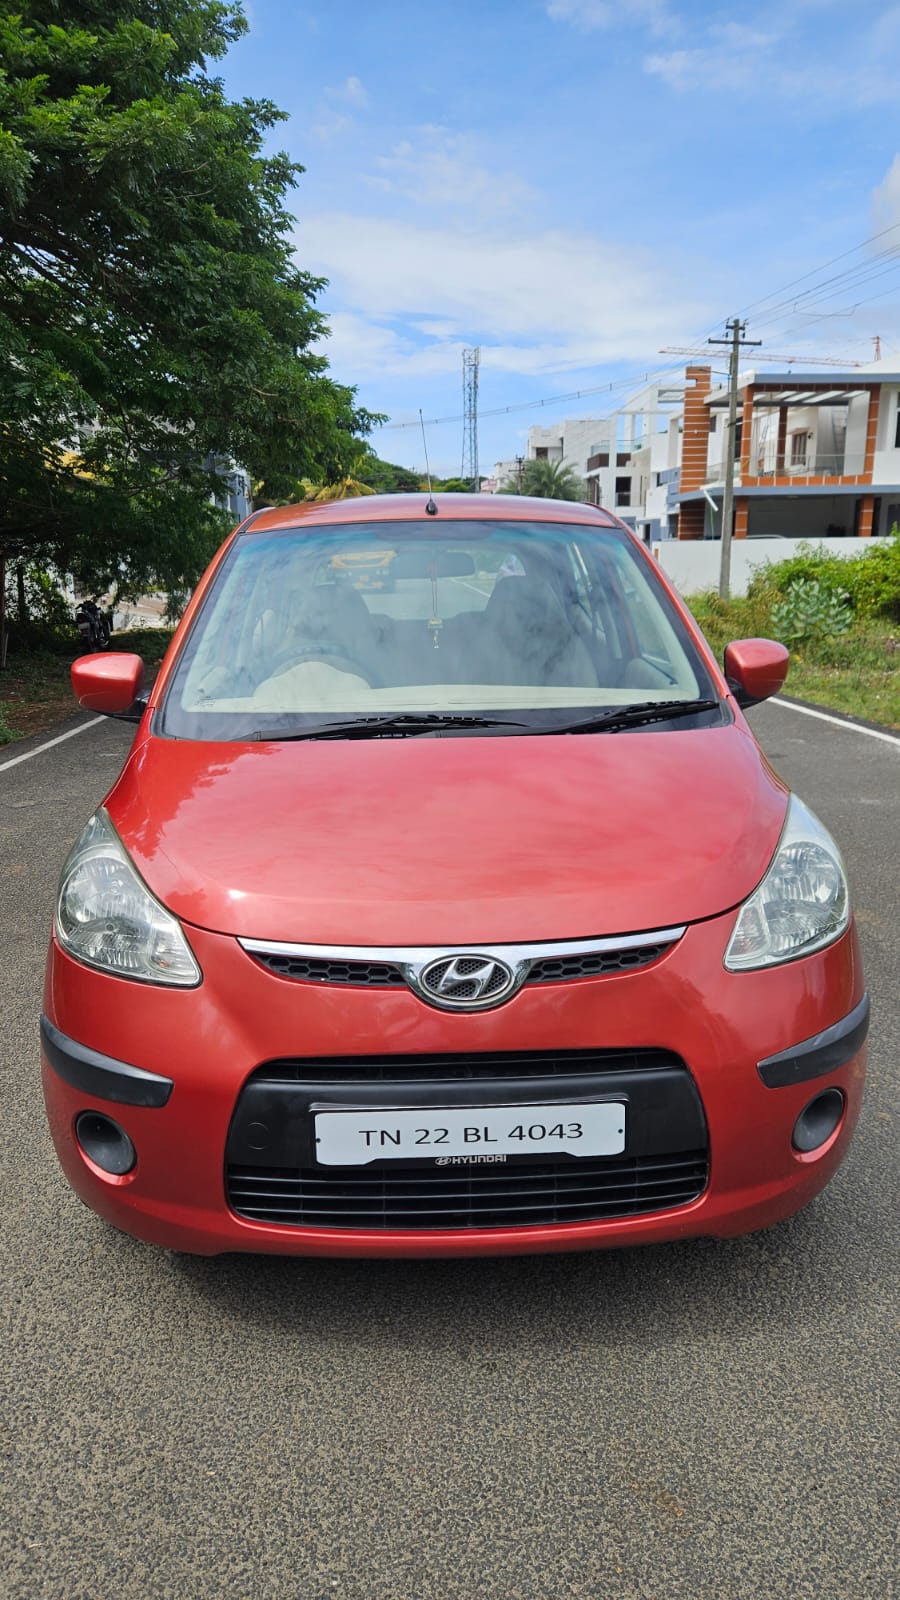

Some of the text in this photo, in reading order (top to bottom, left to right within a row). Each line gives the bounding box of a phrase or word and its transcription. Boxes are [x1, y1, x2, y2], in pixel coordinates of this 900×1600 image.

[358, 1122, 584, 1147] TN 22 BL 4043
[452, 1154, 507, 1165] HYUNDAI
